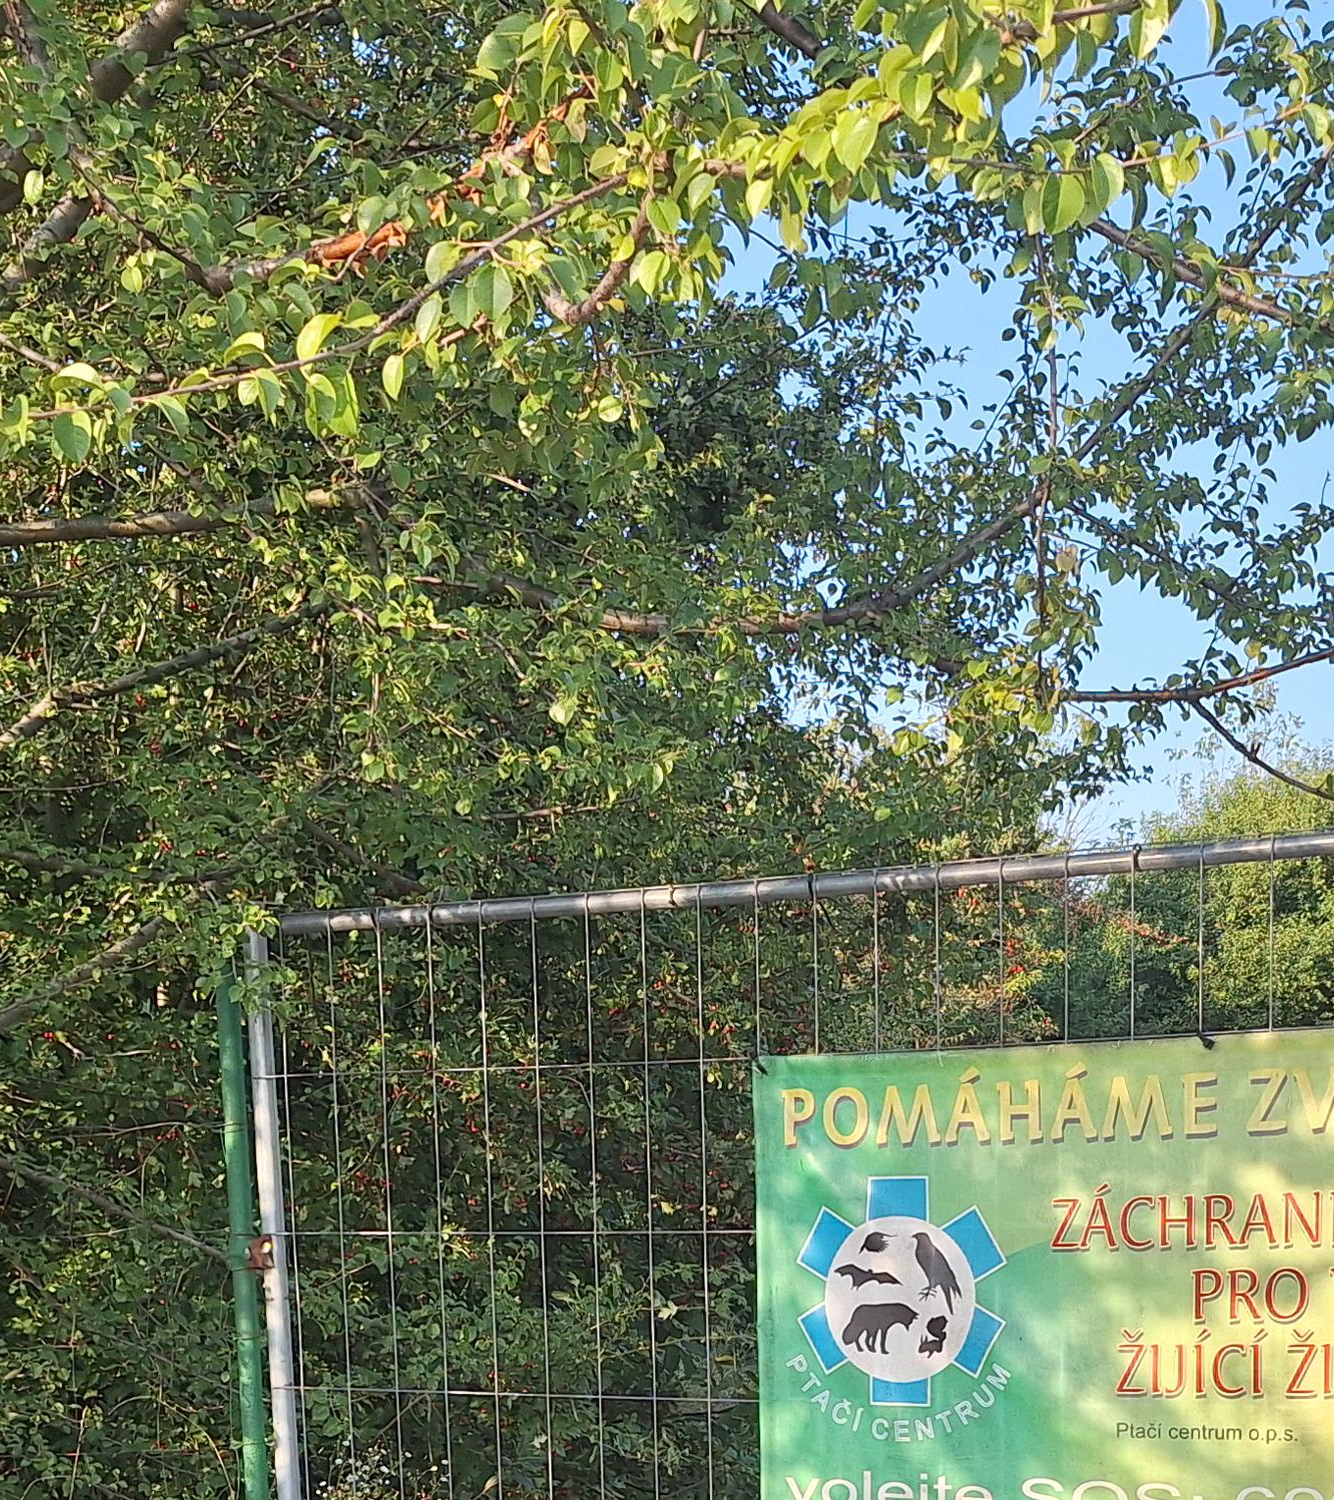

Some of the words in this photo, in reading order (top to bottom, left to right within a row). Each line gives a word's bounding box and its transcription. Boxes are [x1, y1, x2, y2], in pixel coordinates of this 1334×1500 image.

[780, 1062, 1219, 1150] POMÁHÁME
[1191, 1266, 1310, 1325] PRO
[785, 1353, 865, 1432] PTAČÍ
[871, 1362, 1012, 1443] CENTRUM
[1115, 1328, 1267, 1399] ŽIJÍCÍ
[1116, 1422, 1162, 1441] Ptačí
[1168, 1423, 1243, 1441] centrum
[1248, 1427, 1299, 1445] o.p.s.
